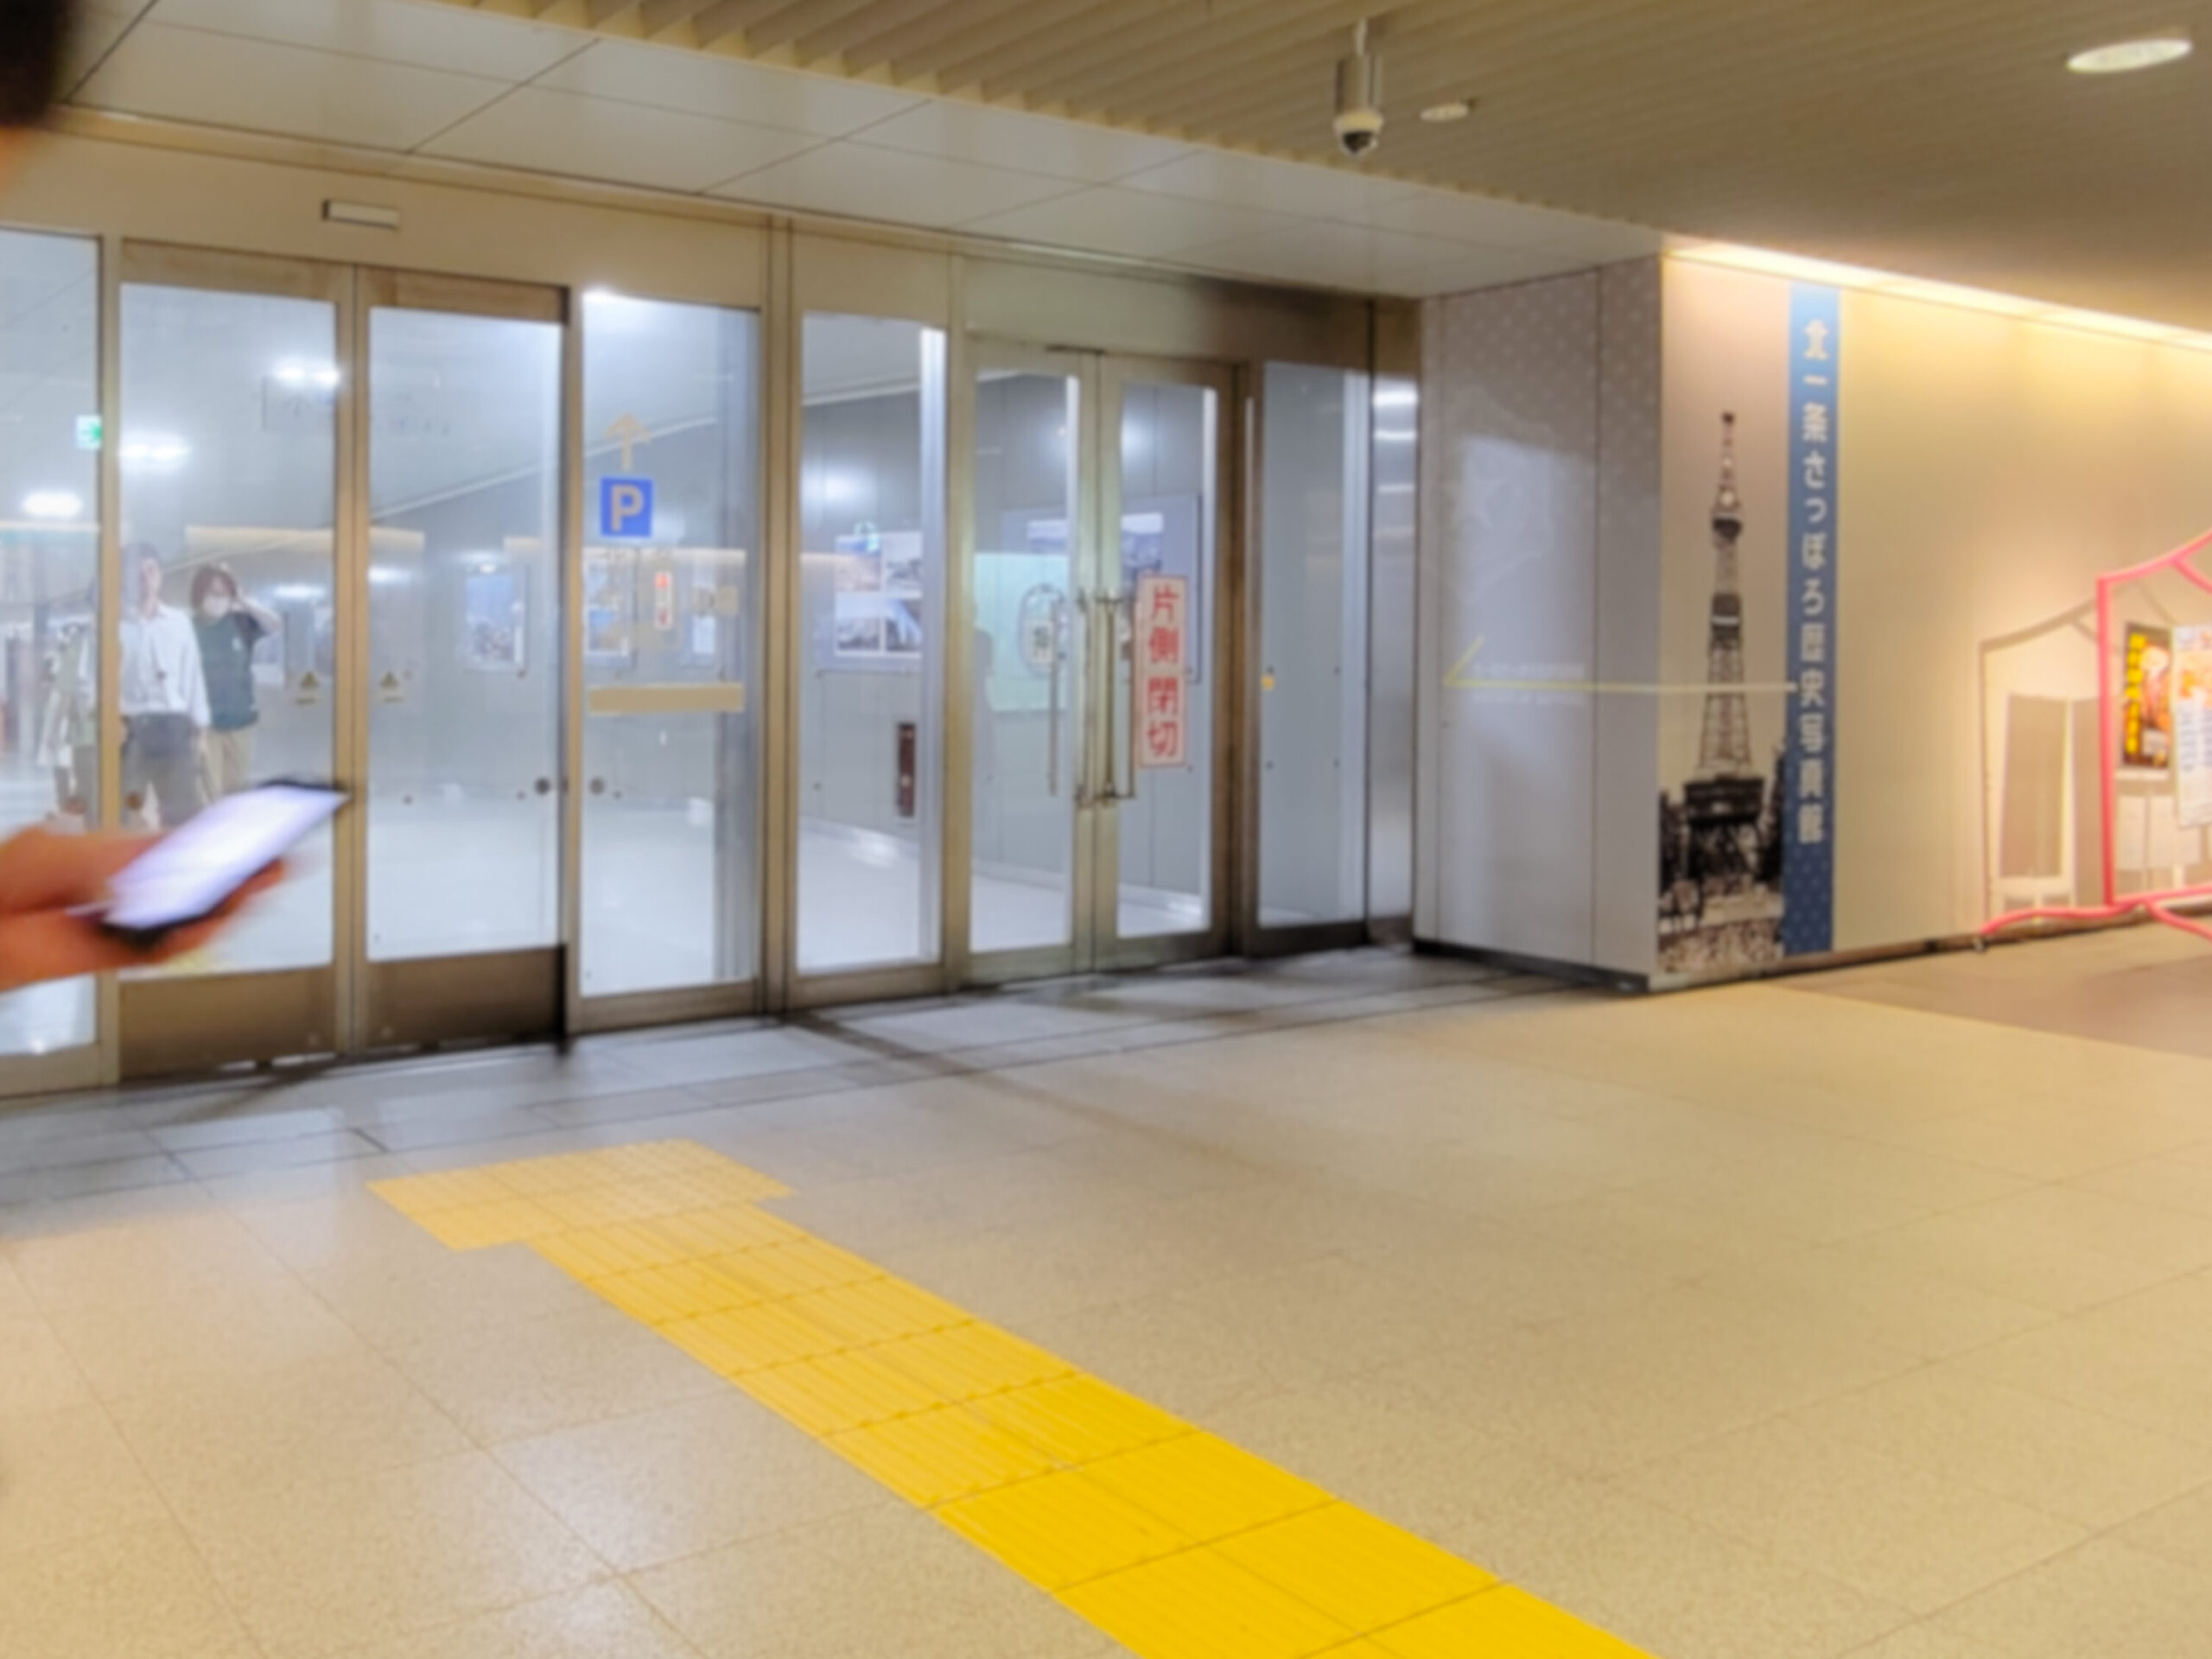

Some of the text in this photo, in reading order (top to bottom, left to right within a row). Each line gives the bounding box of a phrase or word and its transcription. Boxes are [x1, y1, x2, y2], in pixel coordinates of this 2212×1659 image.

[610, 484, 645, 532] P
[1147, 582, 1179, 757] 片側閉切
